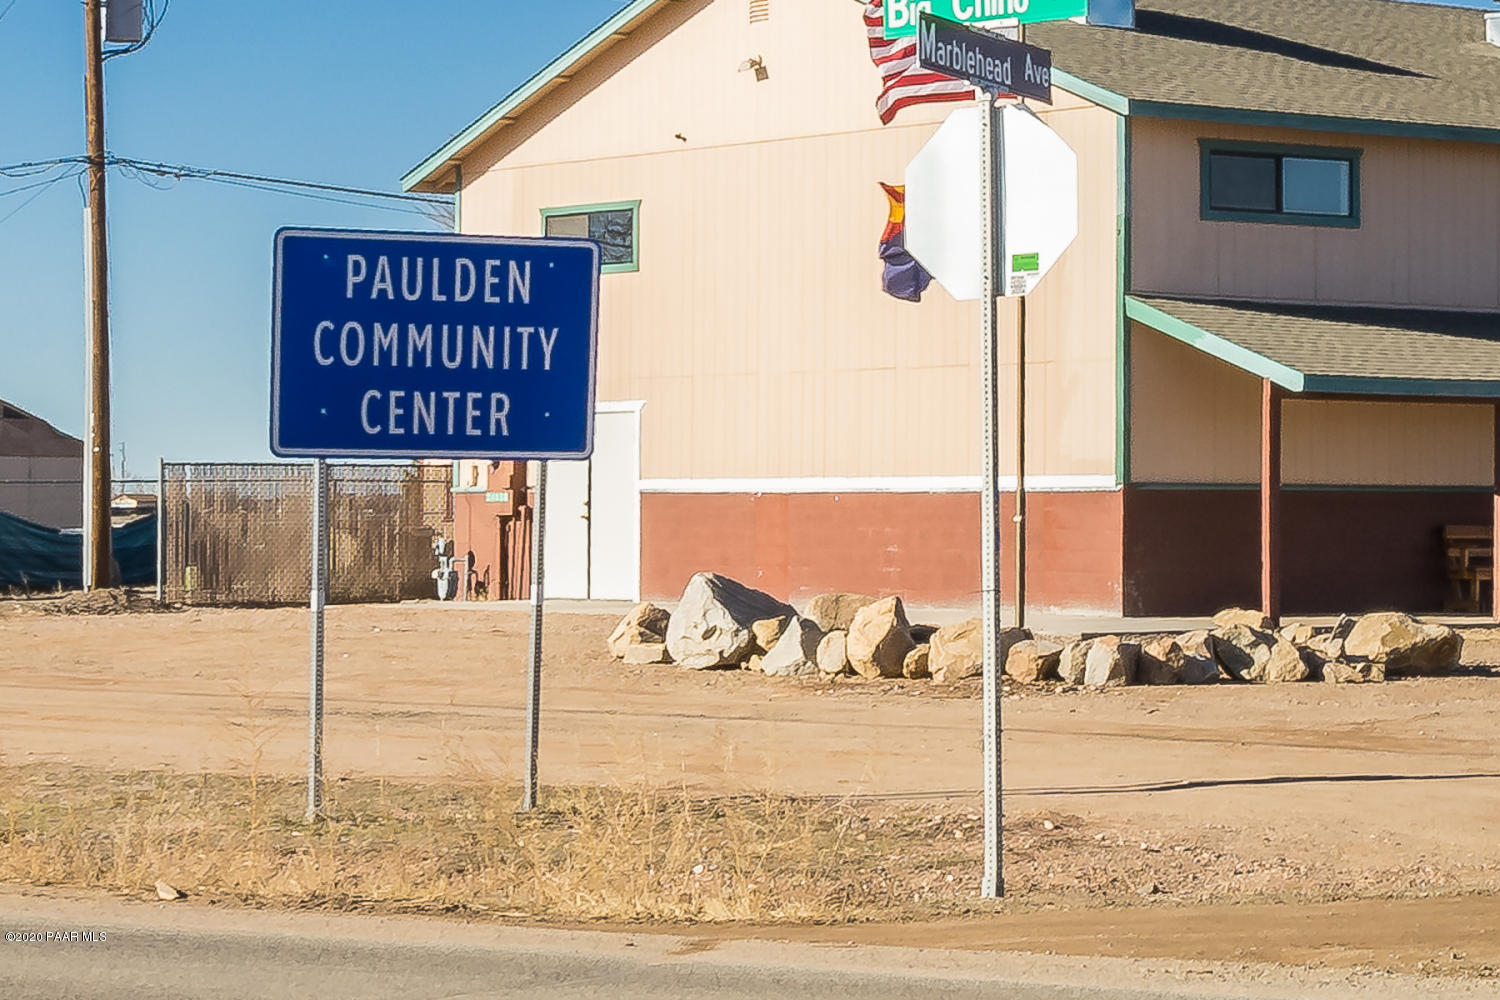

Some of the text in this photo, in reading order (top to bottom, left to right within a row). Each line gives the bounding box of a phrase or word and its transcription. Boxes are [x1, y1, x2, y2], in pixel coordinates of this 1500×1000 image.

[921, 19, 1050, 88] Marblehead Ave
[345, 254, 532, 304] PAULDEN
[313, 320, 560, 370] COMMUNITY
[360, 389, 511, 437] CENTER
